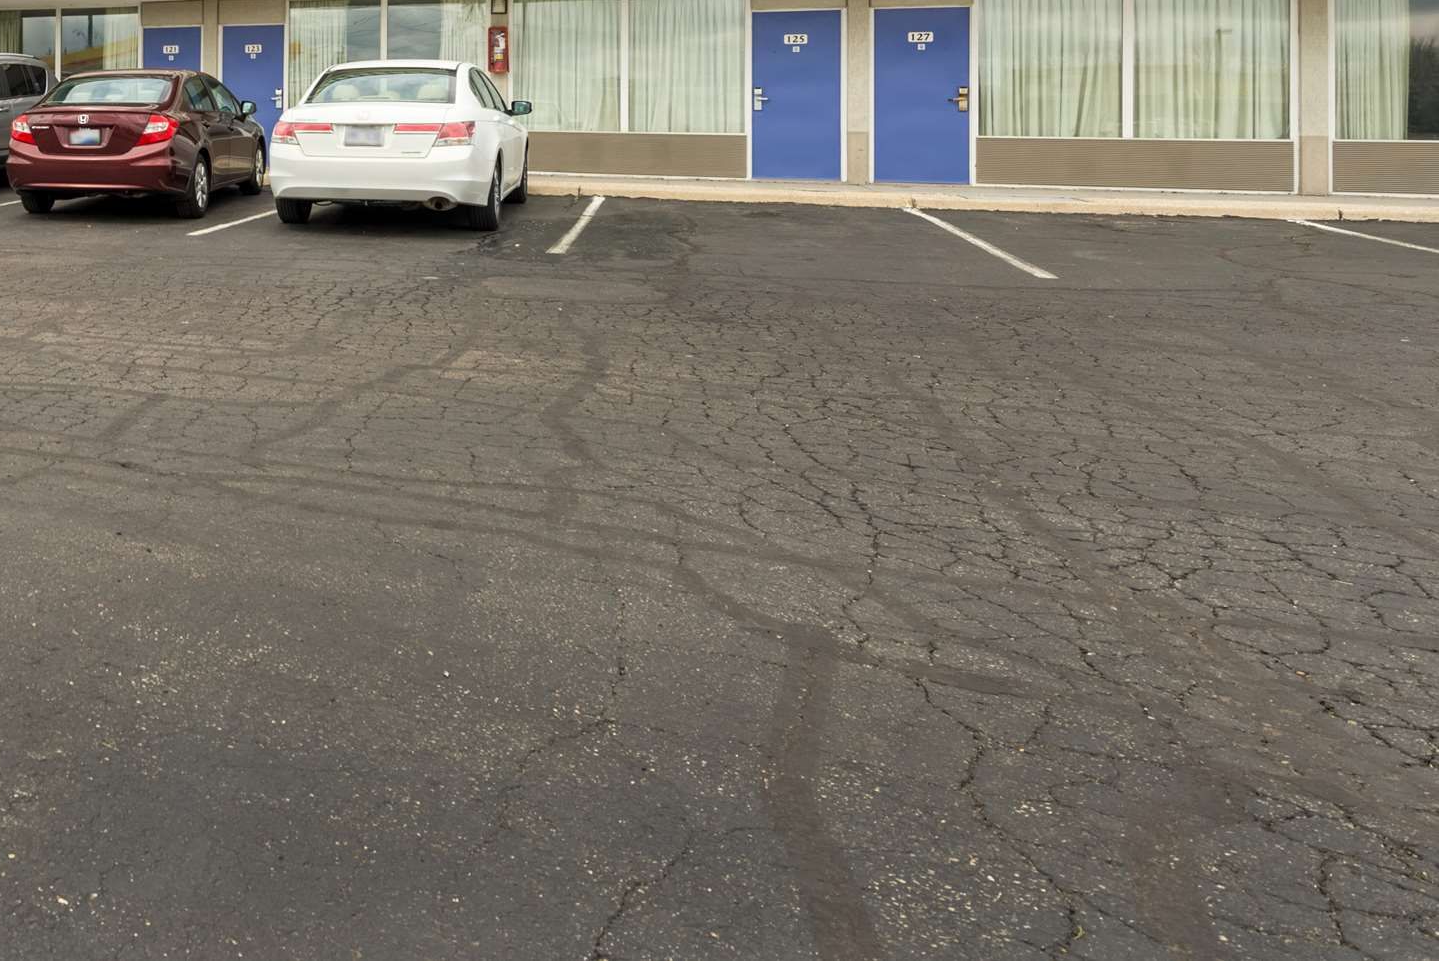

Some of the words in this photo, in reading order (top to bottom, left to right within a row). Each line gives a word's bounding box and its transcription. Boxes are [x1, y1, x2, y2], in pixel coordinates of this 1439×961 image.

[786, 35, 806, 44] 125
[910, 32, 931, 42] 127
[164, 46, 178, 54] 121
[246, 45, 261, 53] 123
